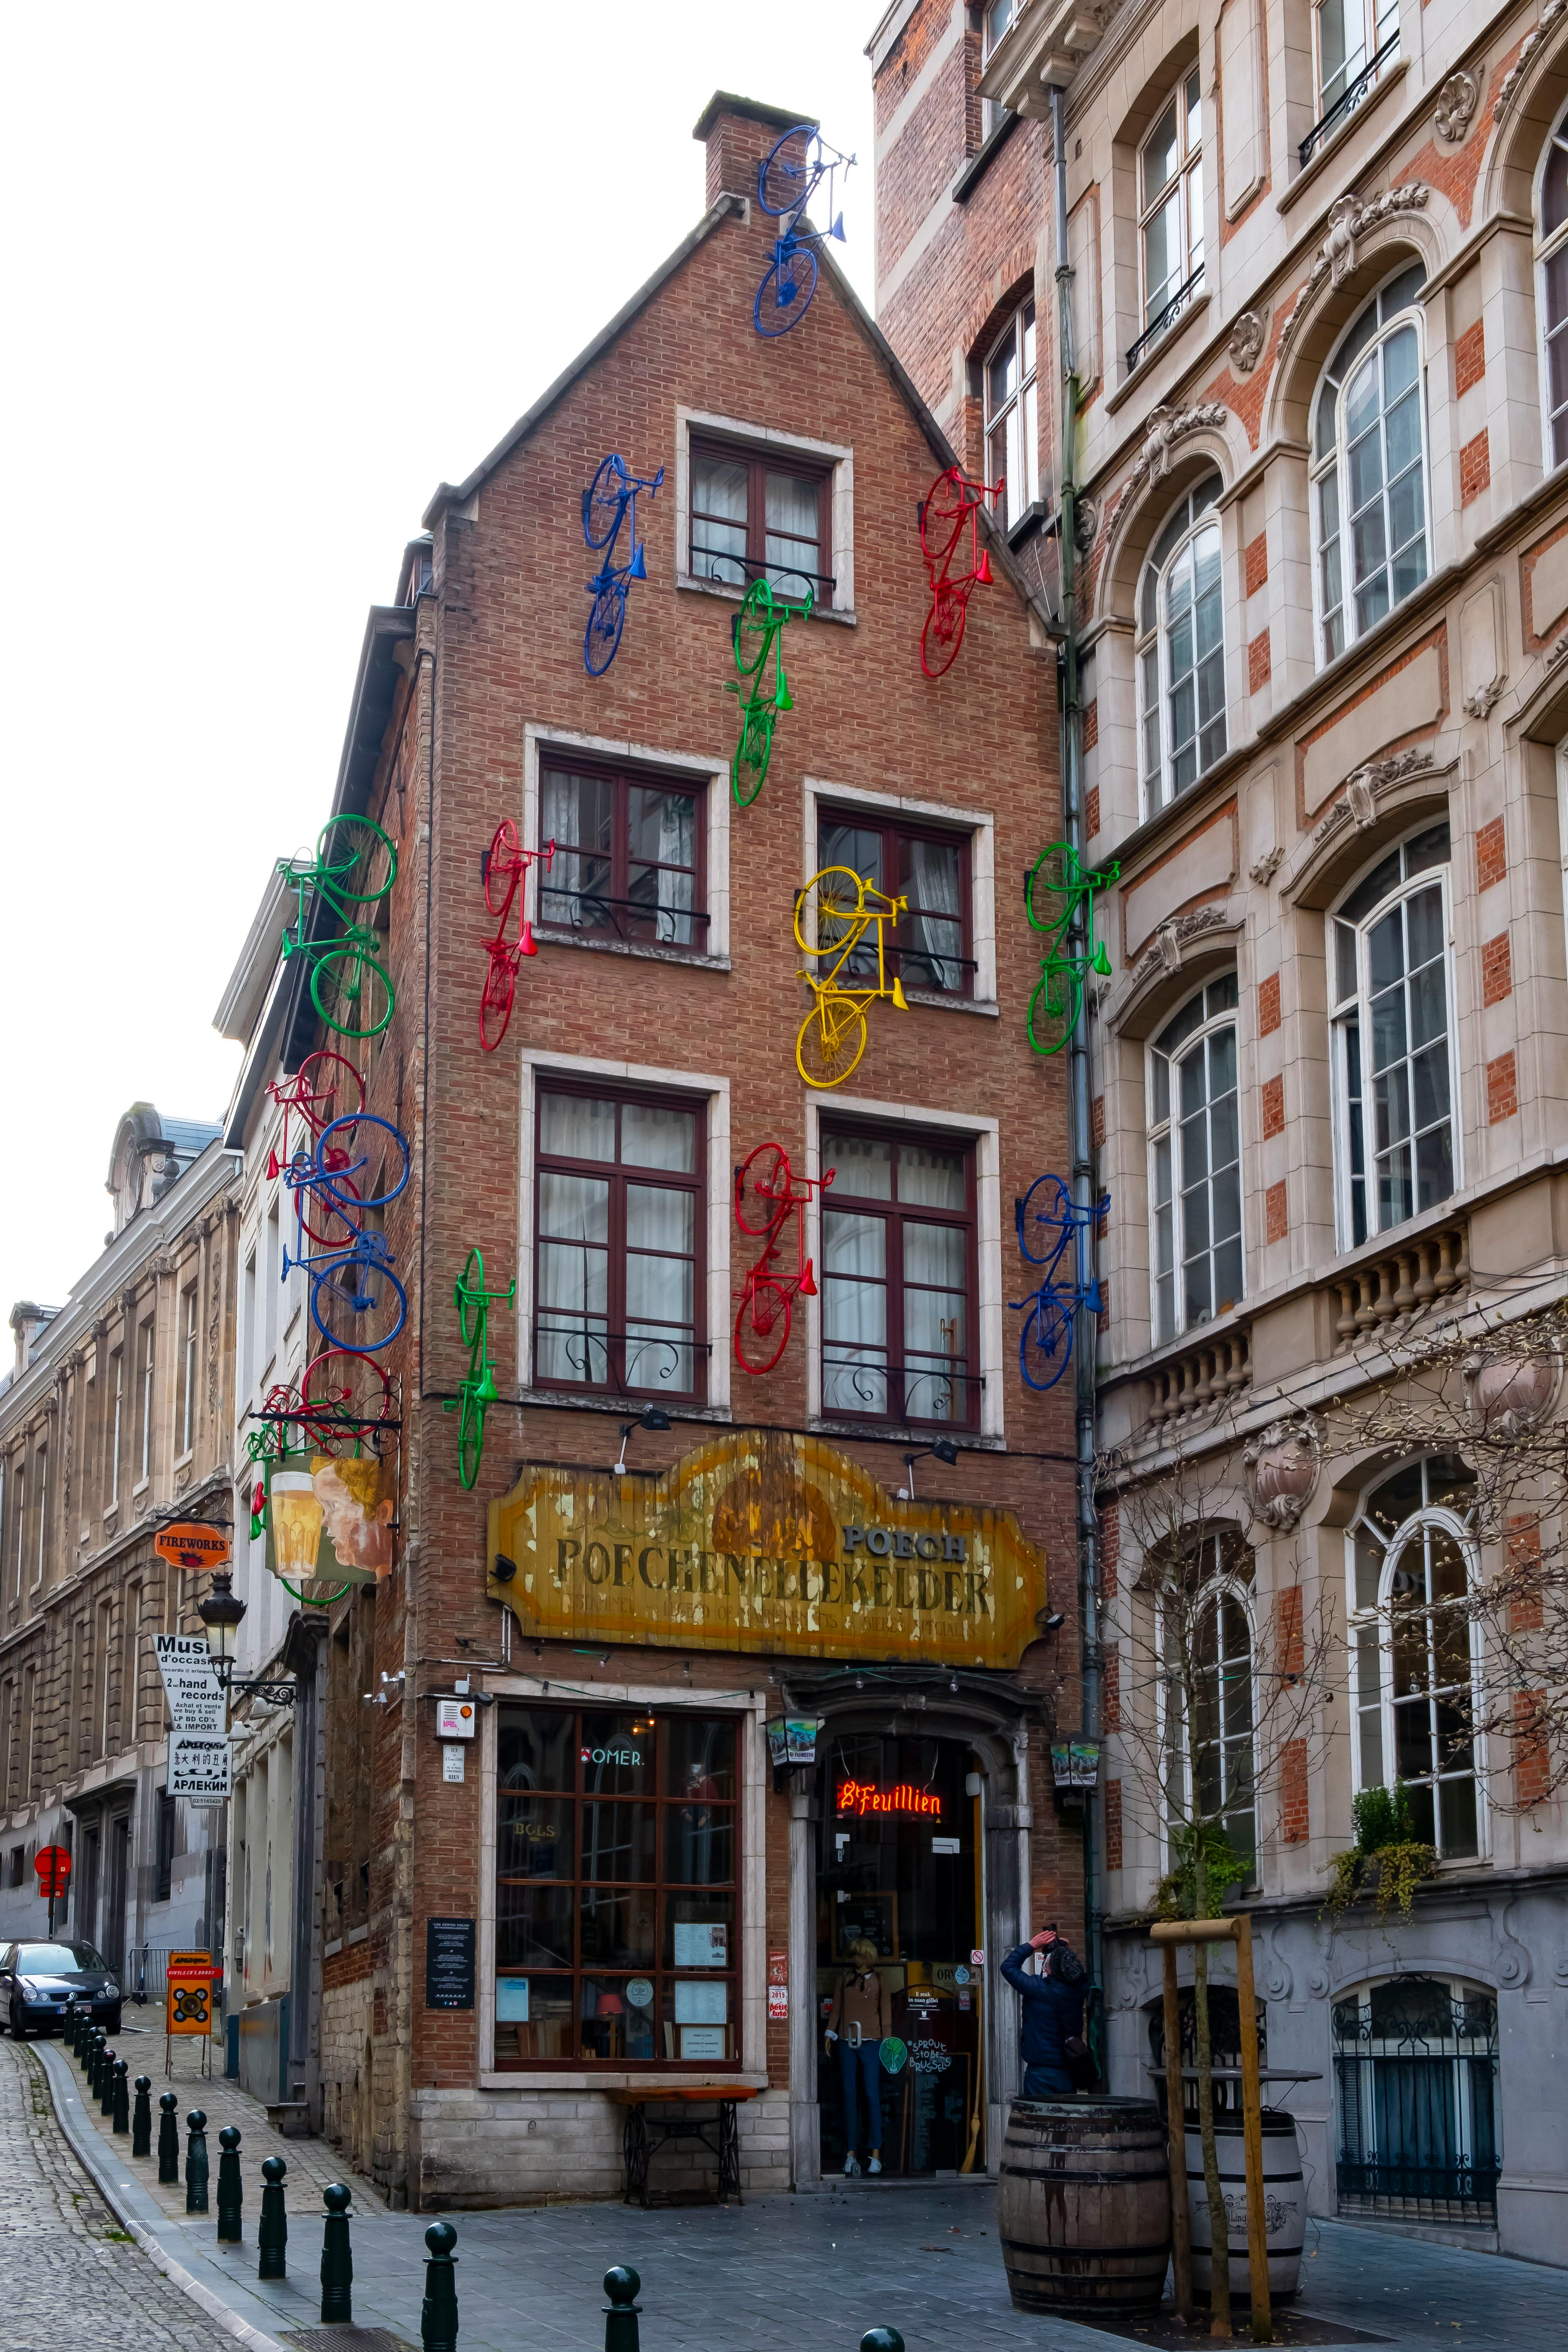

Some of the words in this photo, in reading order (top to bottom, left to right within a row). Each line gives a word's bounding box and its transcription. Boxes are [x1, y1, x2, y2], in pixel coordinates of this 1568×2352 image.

[159, 1535, 225, 1551] FIREWORKS
[843, 1525, 967, 1561] POECH
[557, 1539, 990, 1614] POECHENELLEKELDER
[663, 1601, 710, 1619] LEGED
[718, 1606, 733, 1620] OF
[157, 1636, 211, 1654] Musi
[179, 1678, 207, 1689] hand
[181, 1691, 225, 1700] records
[174, 1751, 228, 1767] 意大利的丑角
[173, 1780, 227, 1791] АРЛЕКИН
[860, 1785, 940, 1815] Feuillien
[515, 1823, 555, 1837] BOLS
[769, 2003, 787, 2011] petit
[910, 2057, 951, 2073] BRUSSELS
